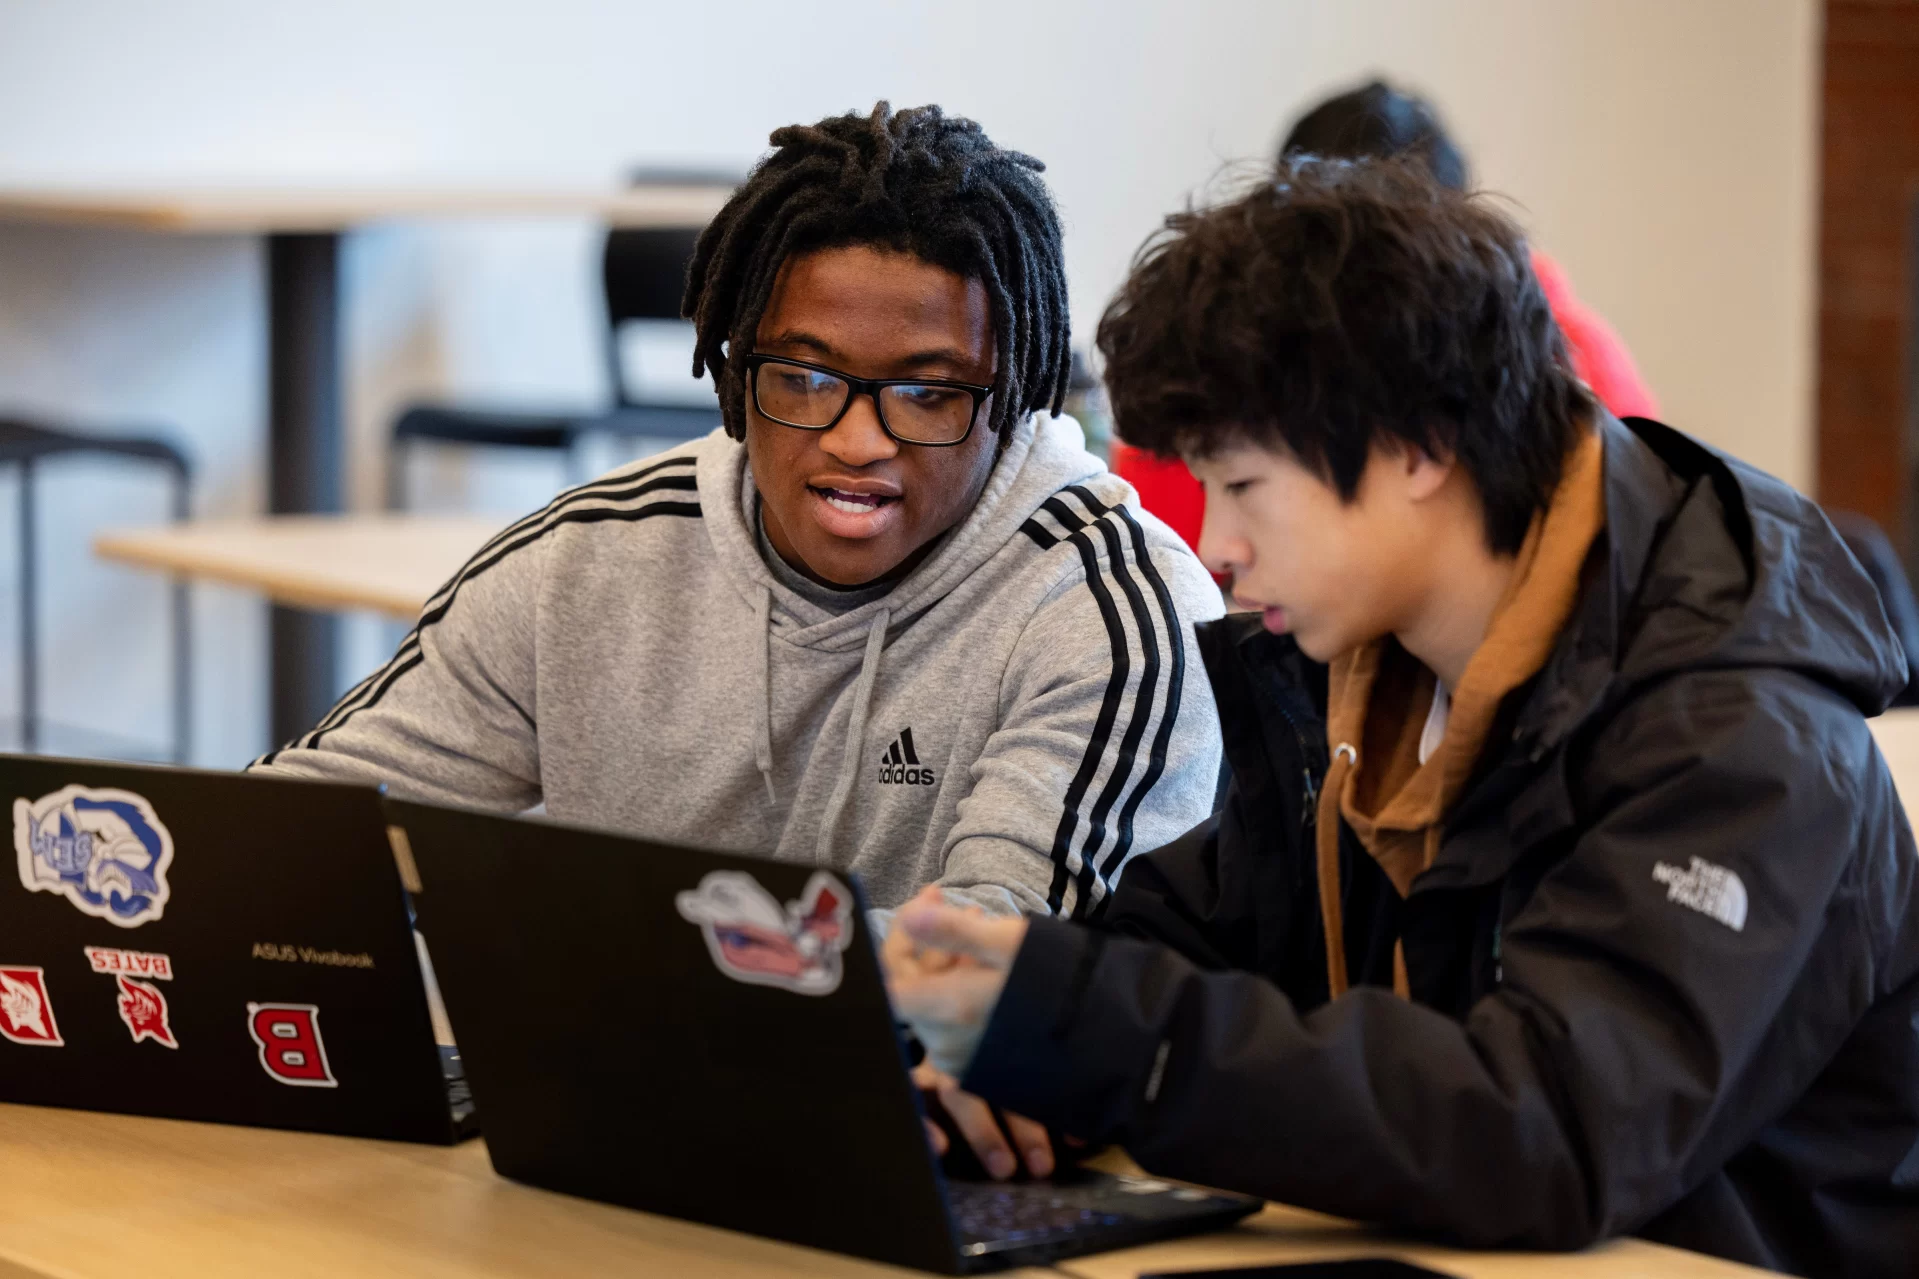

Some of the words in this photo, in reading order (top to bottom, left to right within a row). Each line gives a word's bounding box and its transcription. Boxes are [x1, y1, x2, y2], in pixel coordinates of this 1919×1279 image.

[878, 763, 935, 786] adidas
[90, 949, 169, 977] BATES
[252, 942, 298, 963] ASUS
[250, 1005, 334, 1084] B
